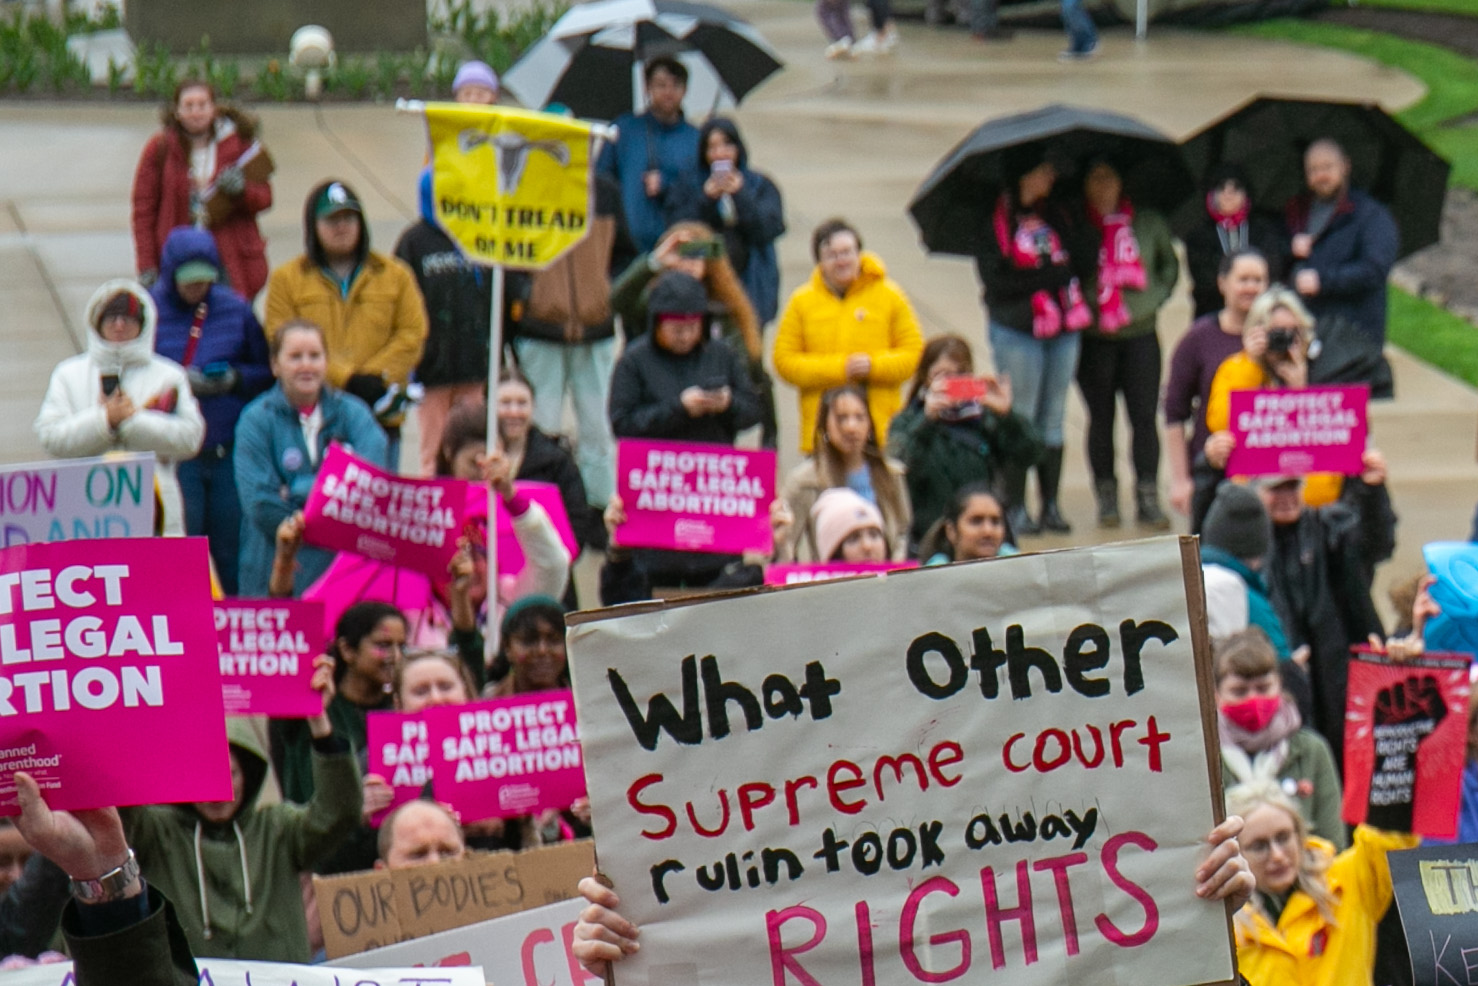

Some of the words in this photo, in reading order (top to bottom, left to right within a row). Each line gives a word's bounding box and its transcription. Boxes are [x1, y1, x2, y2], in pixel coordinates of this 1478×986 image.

[505, 207, 585, 228] TREAD
[504, 239, 537, 259] ME
[1254, 392, 1344, 411] PROTECT
[1245, 428, 1351, 449] ABORTION
[647, 450, 749, 477] PROTECT
[85, 463, 142, 507] ON
[344, 461, 445, 508] PROTECT
[629, 468, 692, 492] SAFE,
[697, 473, 765, 499] LEGAL
[387, 501, 457, 530] LEGAL
[637, 490, 756, 518] ABORTION
[321, 498, 446, 548] ABORTION
[229, 631, 310, 654] LEGAL
[606, 652, 842, 752] What
[906, 619, 1180, 701] Other
[458, 700, 568, 735] PROTECT
[442, 733, 512, 762] SAFE,
[1002, 714, 1171, 773] court
[455, 745, 580, 783] ABORTION
[650, 846, 804, 904] rulin
[813, 819, 946, 876] took
[963, 804, 1098, 851] away
[332, 880, 397, 936] OUR
[406, 866, 526, 918] BODIES
